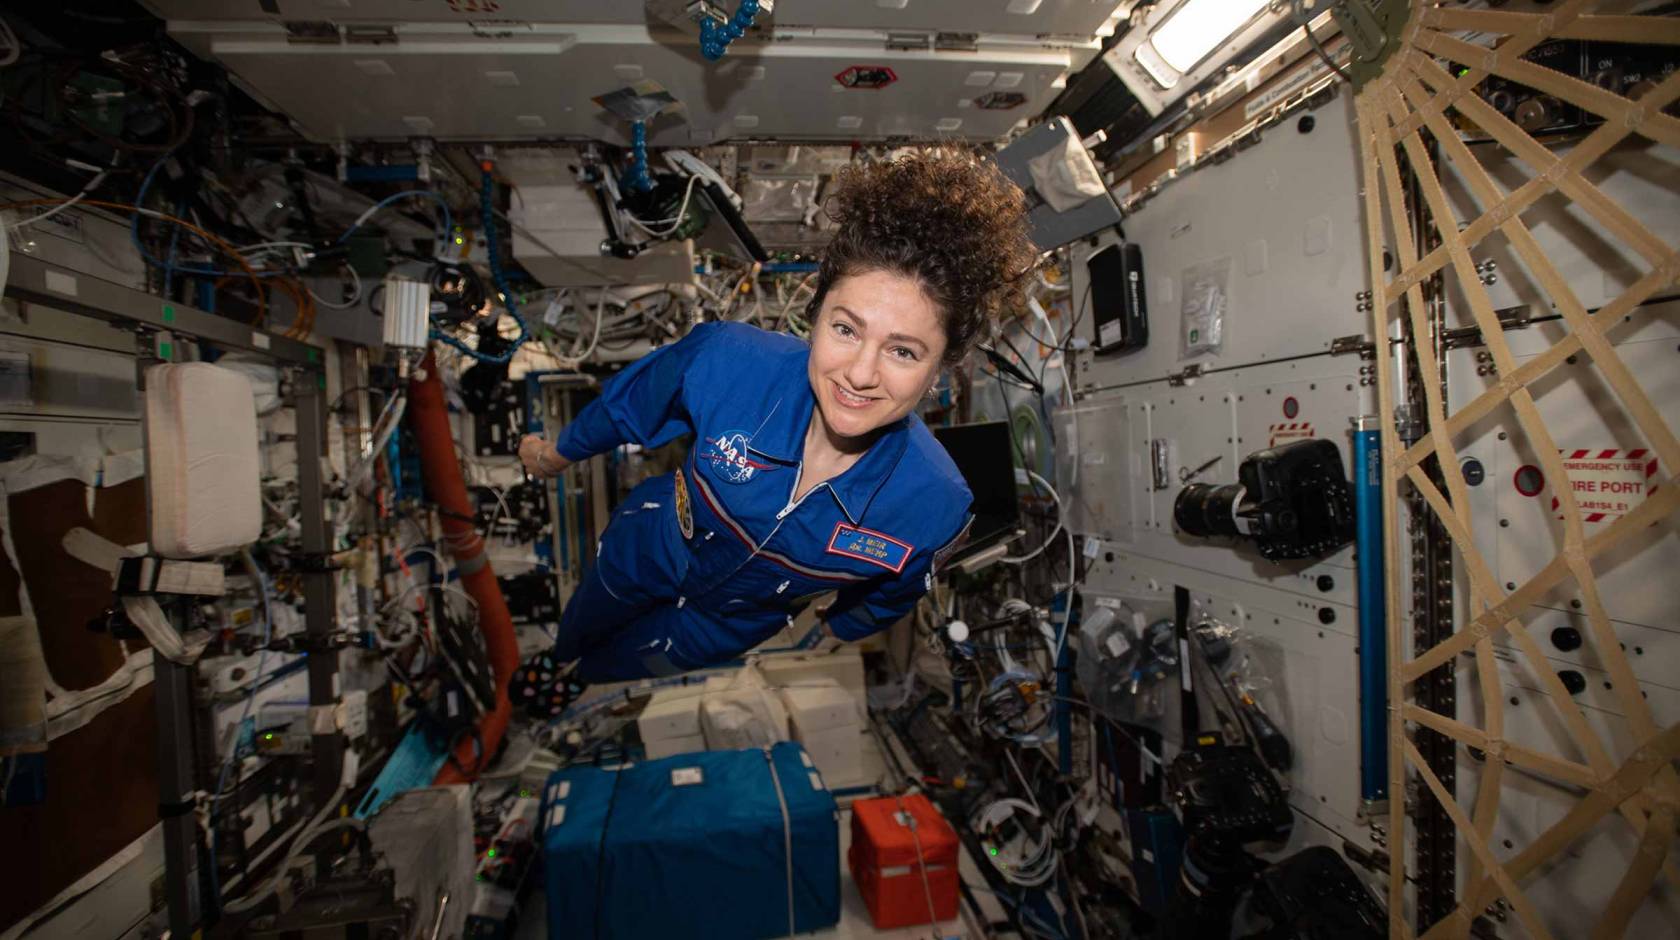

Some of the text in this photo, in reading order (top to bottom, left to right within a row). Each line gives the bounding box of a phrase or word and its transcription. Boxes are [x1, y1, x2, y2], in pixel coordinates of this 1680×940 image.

[1598, 59, 1613, 70] ON
[1271, 70, 1310, 99] Combustion
[715, 435, 755, 480] NASA
[1623, 463, 1644, 472] USE
[1571, 480, 1643, 494] IRE PORT
[866, 537, 887, 549] MEIR
